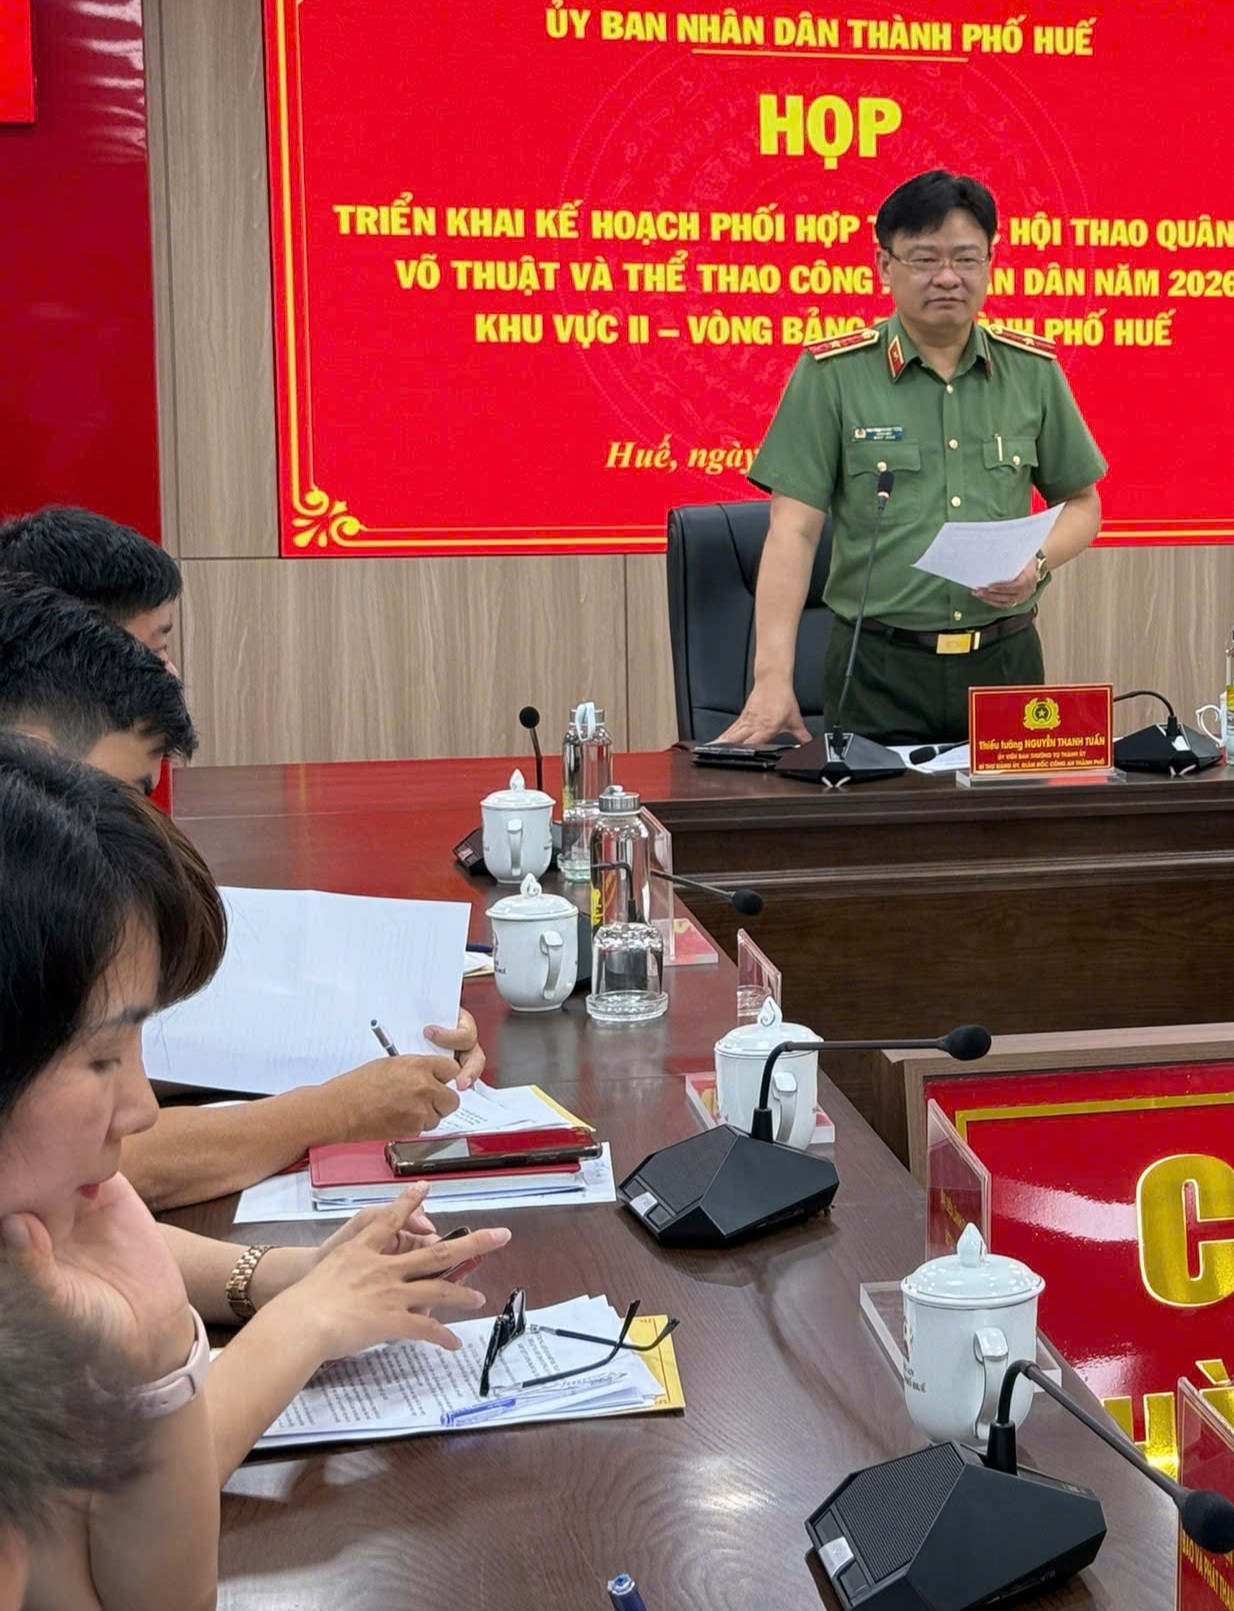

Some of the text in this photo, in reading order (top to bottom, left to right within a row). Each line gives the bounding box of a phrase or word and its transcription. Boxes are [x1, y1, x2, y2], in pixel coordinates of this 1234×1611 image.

[546, 0, 1096, 55] ỦY BAN NHÂN DÂN THÀNH PHỐ HUẾ
[760, 94, 901, 169] HỌP
[333, 192, 436, 235] TRIỂN
[447, 208, 524, 237] KHAI
[536, 200, 582, 238] KẾ
[592, 211, 699, 245] HOẠCH
[711, 204, 784, 242] PHỐI
[796, 211, 860, 247] HỢP
[1010, 212, 1061, 250] HỘI
[1070, 219, 1148, 247] THAO
[1156, 215, 1234, 251] QUÂN
[395, 254, 440, 289] VÕ
[451, 256, 560, 295] THUẬT
[570, 256, 613, 291] VÀ
[623, 250, 688, 291] THỂ
[697, 265, 780, 293] THAO
[790, 260, 873, 294] CÔNG
[1024, 263, 1085, 295] DÂN
[1095, 264, 1159, 296] NĂM
[476, 314, 542, 343] KHU
[553, 310, 618, 348] VỰC
[629, 316, 649, 343] II
[688, 310, 772, 344] VÒNG
[1044, 308, 1107, 346] PHỐ
[1115, 309, 1175, 346] HUẾ
[607, 435, 677, 470] Huế,
[1058, 737, 1083, 748] THANH
